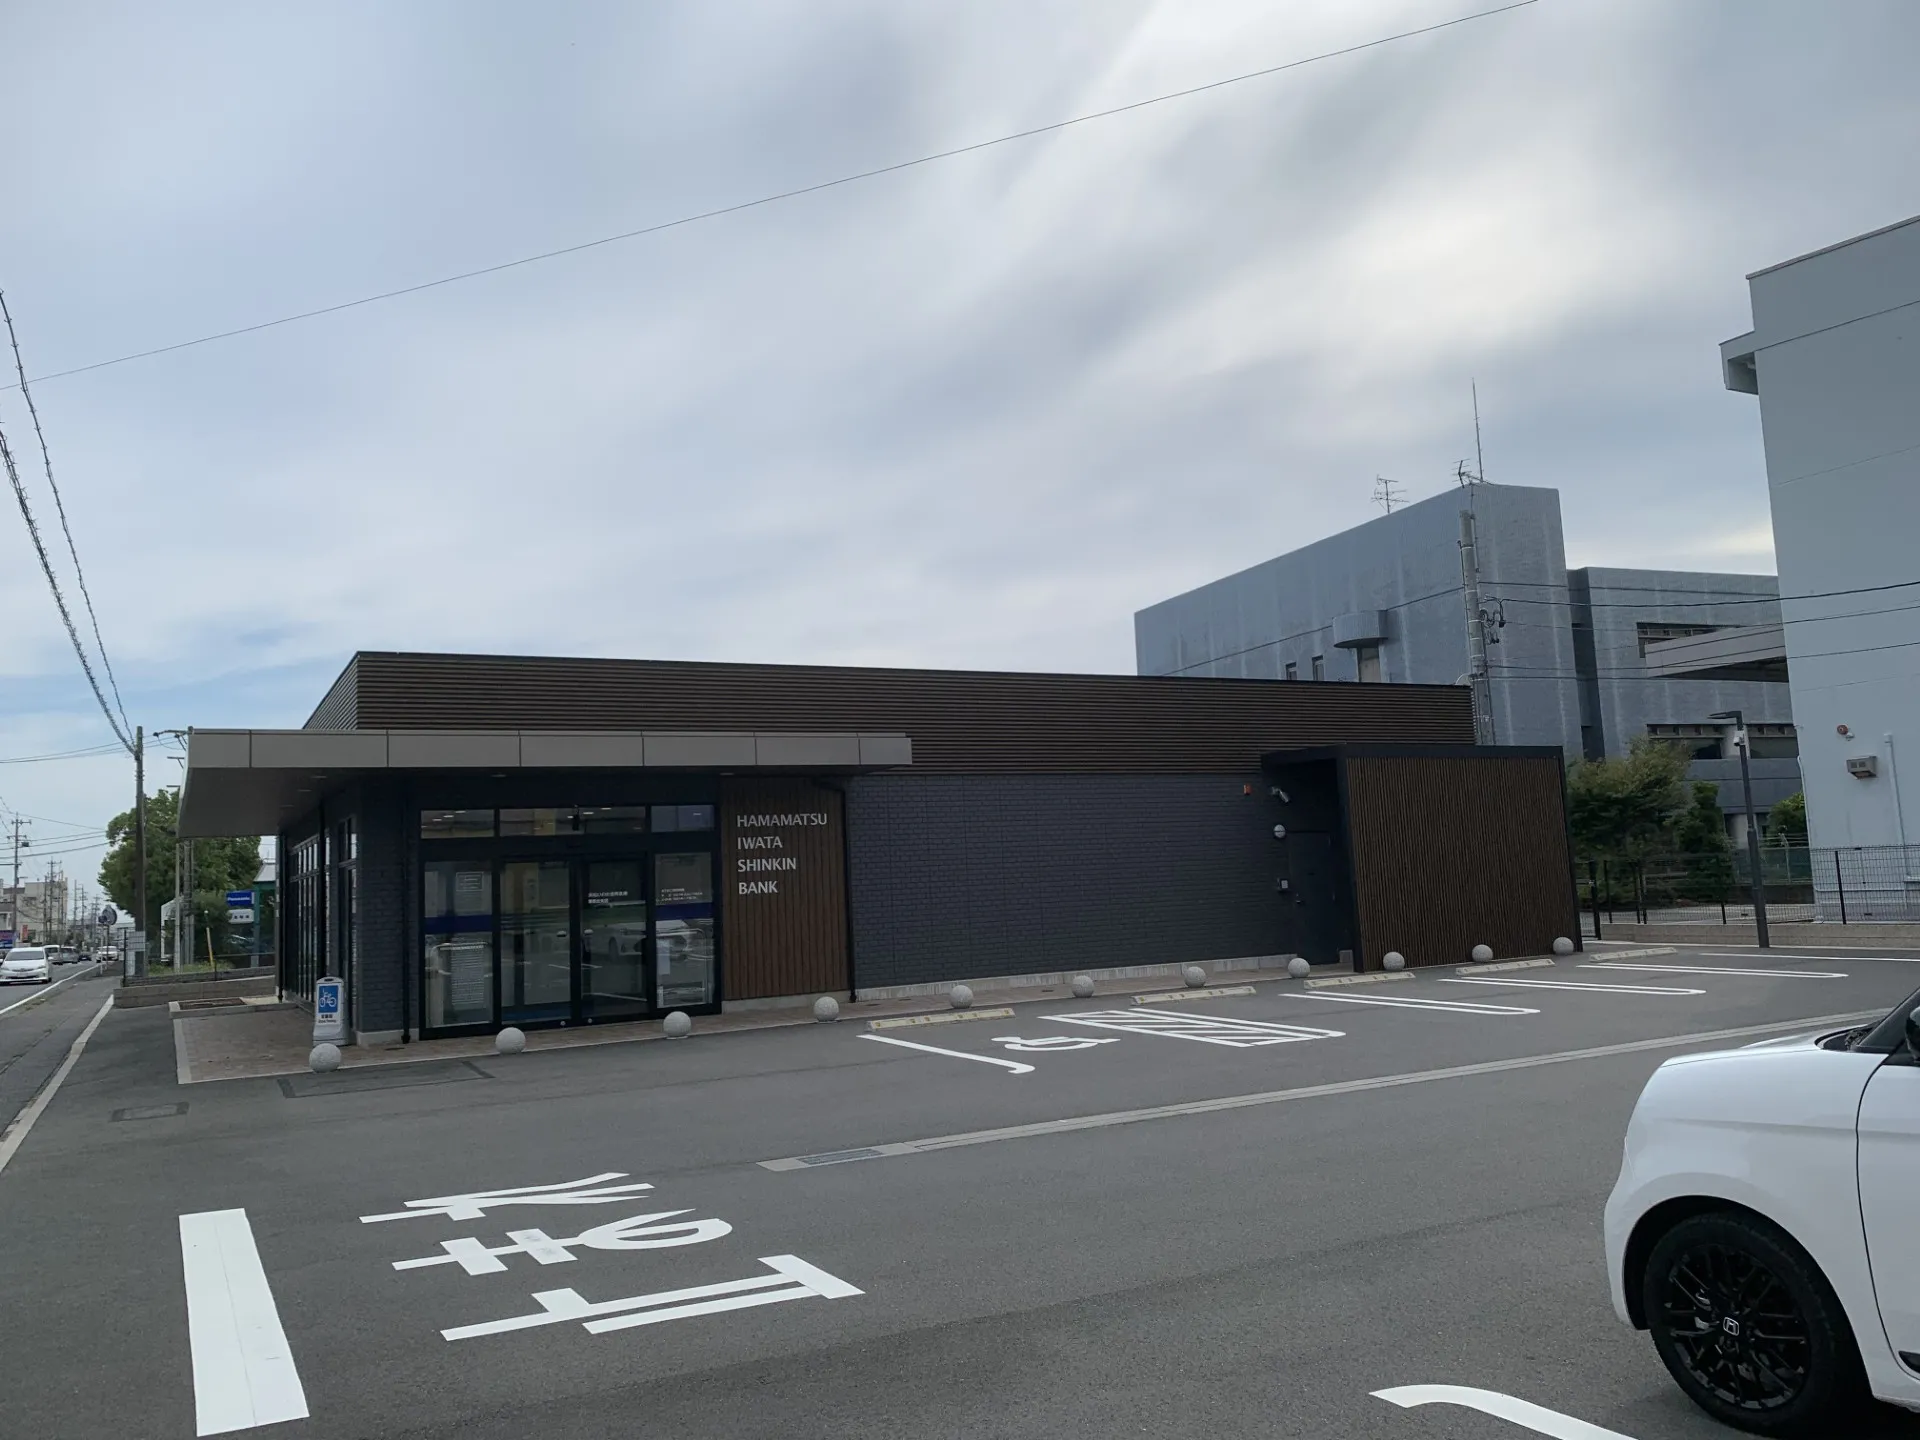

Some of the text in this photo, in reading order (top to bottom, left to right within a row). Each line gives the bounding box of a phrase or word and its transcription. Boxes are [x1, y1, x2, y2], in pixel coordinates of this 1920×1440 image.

[736, 813, 828, 828] HAMAMATSU
[737, 836, 783, 850] IWATA
[737, 857, 797, 873] SHINKIN
[738, 880, 778, 895] BANK
